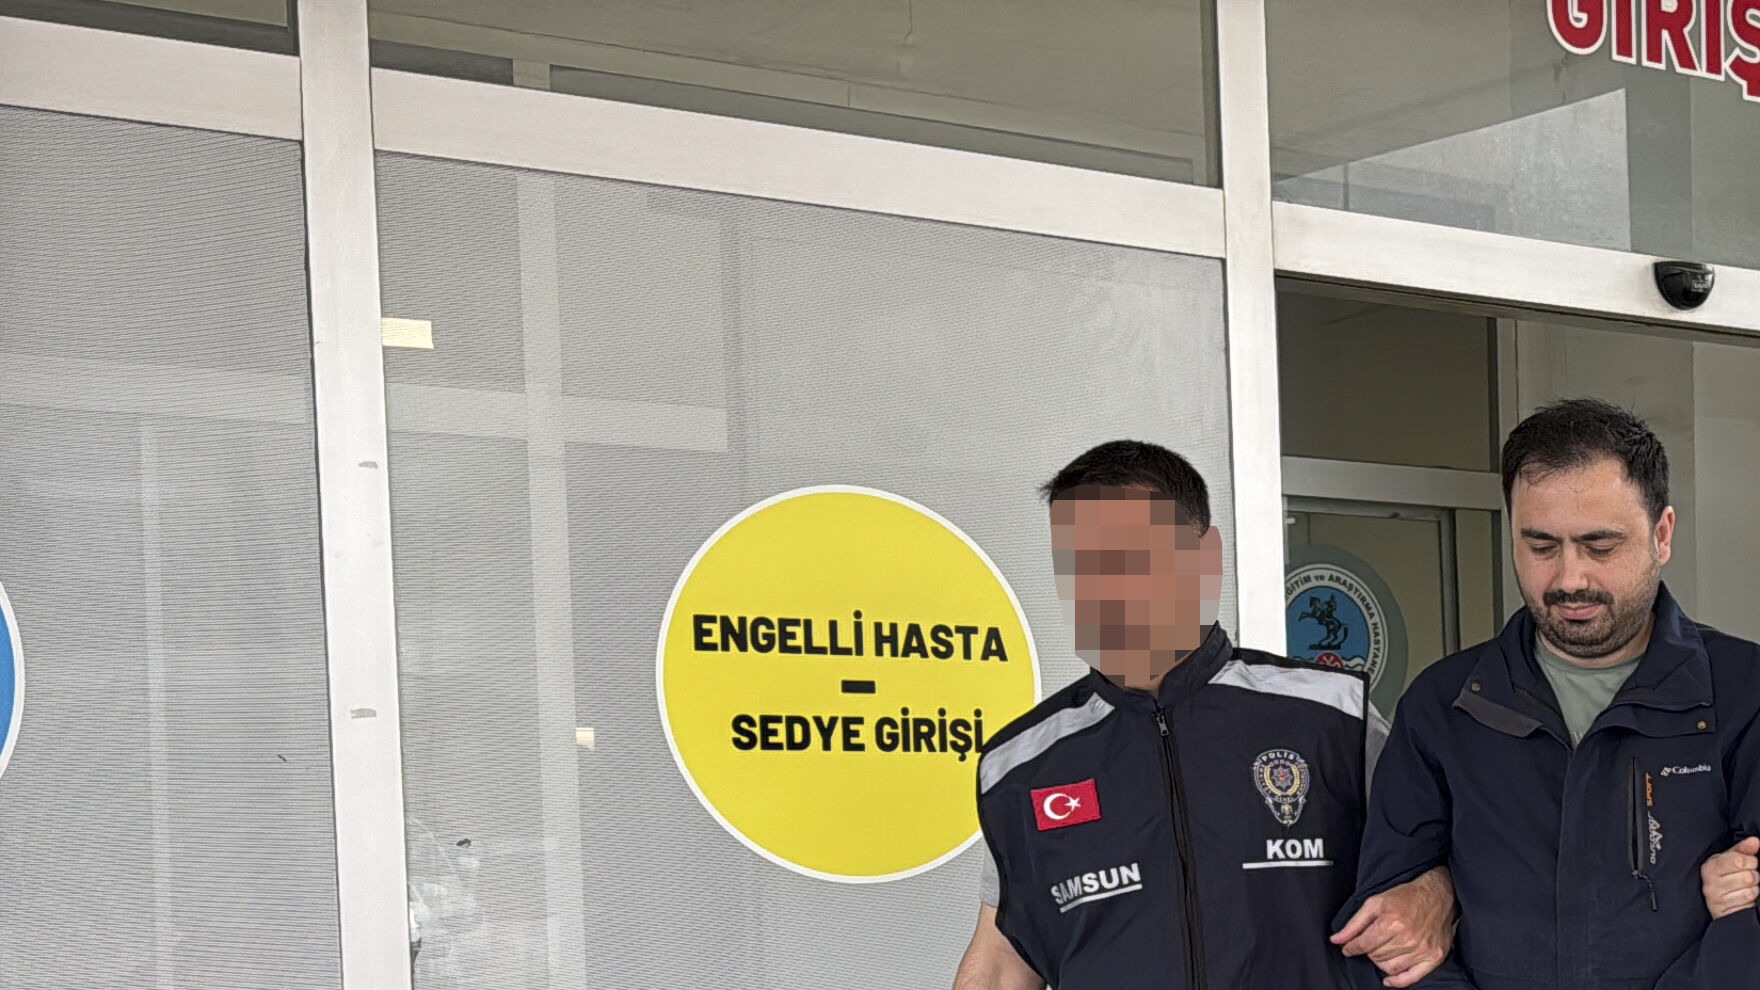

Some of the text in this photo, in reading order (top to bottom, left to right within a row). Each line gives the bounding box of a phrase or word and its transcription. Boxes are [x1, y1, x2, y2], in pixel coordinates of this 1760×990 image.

[1286, 574, 1312, 596] ĞİTİM
[1328, 574, 1376, 621] ARAŞTIRMA
[692, 610, 1009, 662] ENGELLİ HASTA
[731, 706, 985, 762] SEDYE GİRİŞİ
[1671, 764, 1711, 775] Columbia
[1266, 838, 1324, 860] KOM
[1051, 863, 1141, 904] SAMSUN
